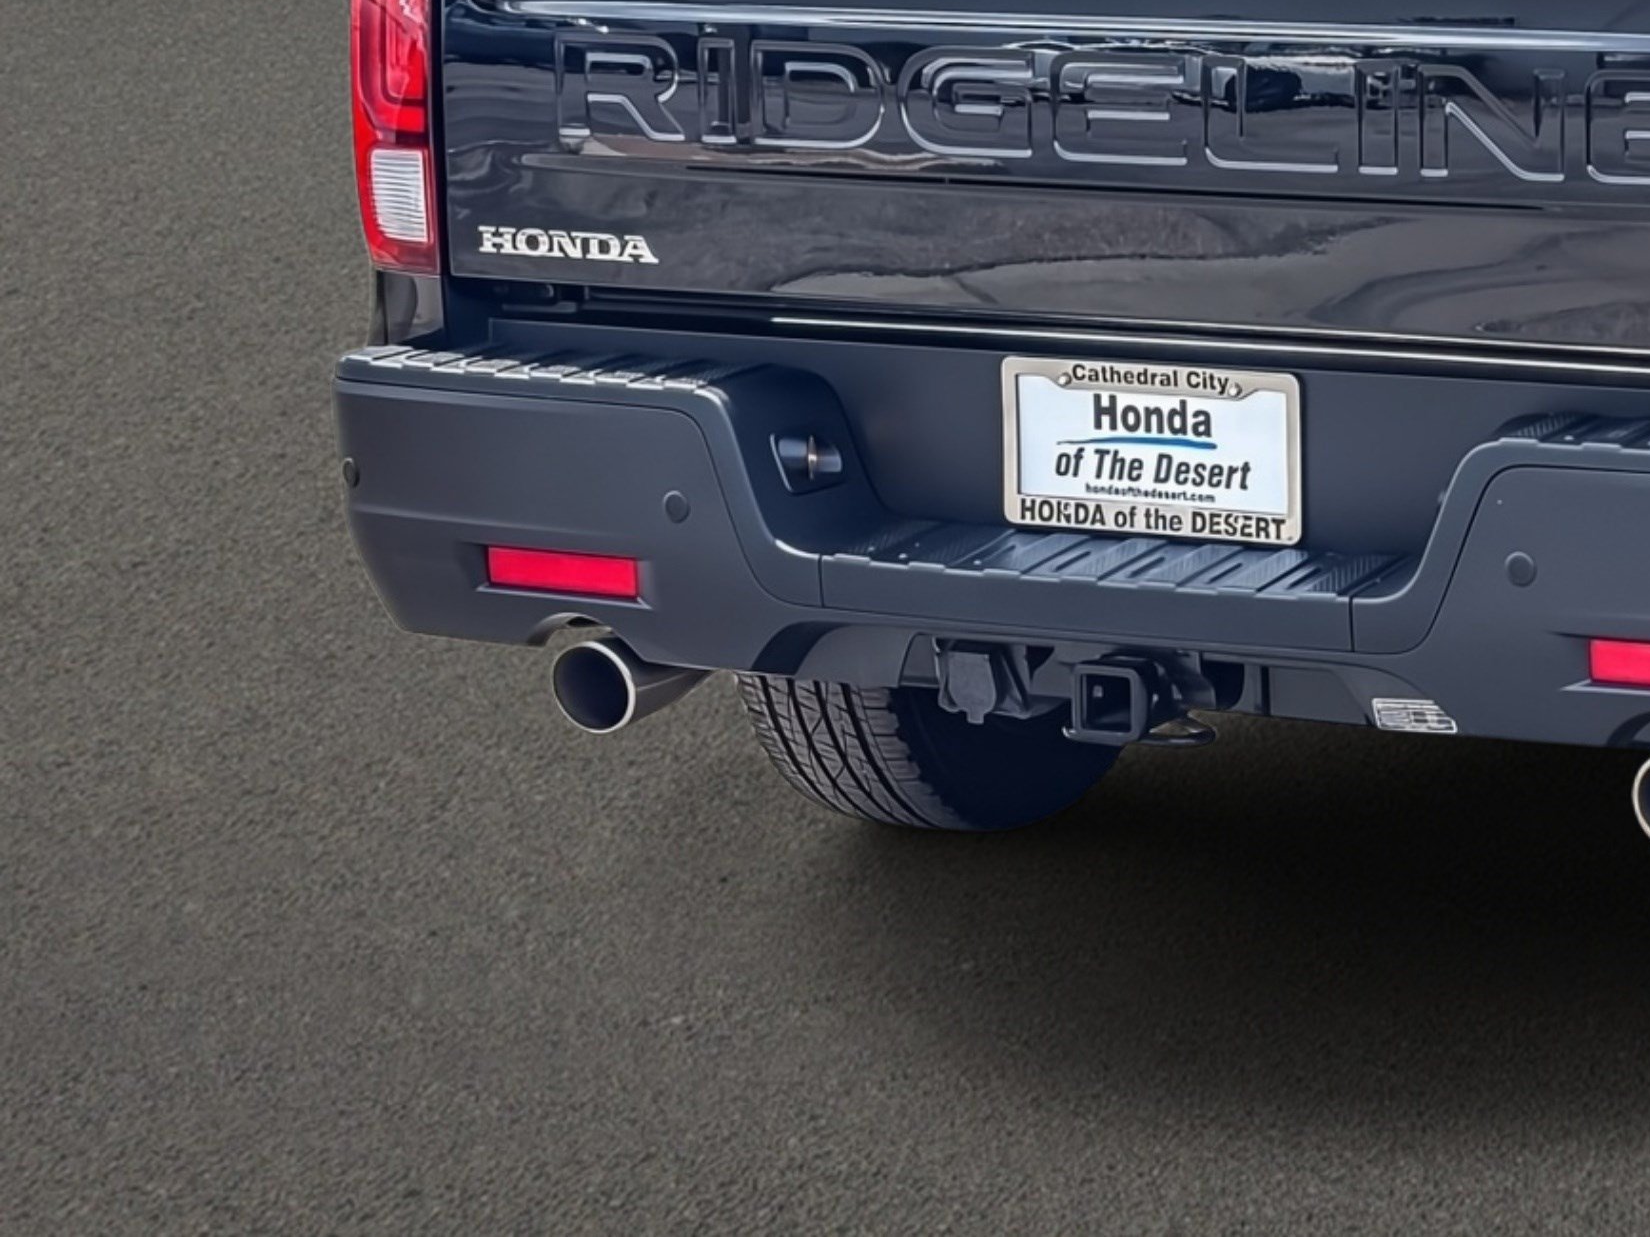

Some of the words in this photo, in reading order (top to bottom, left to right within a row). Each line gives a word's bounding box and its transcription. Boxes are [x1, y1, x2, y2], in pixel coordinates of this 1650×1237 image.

[477, 224, 660, 265] HONDA
[1071, 363, 1179, 388] Cathedral
[1185, 370, 1230, 395] City
[1092, 392, 1213, 438] Honda
[1055, 446, 1086, 479] of
[1094, 448, 1145, 482] The
[1153, 452, 1252, 491] Desert
[1085, 482, 1217, 504] hondaofthedesert.com
[1019, 497, 1107, 527] HONDA
[1113, 505, 1138, 530] of
[1143, 508, 1184, 533] the
[1190, 511, 1287, 541] DESERT
